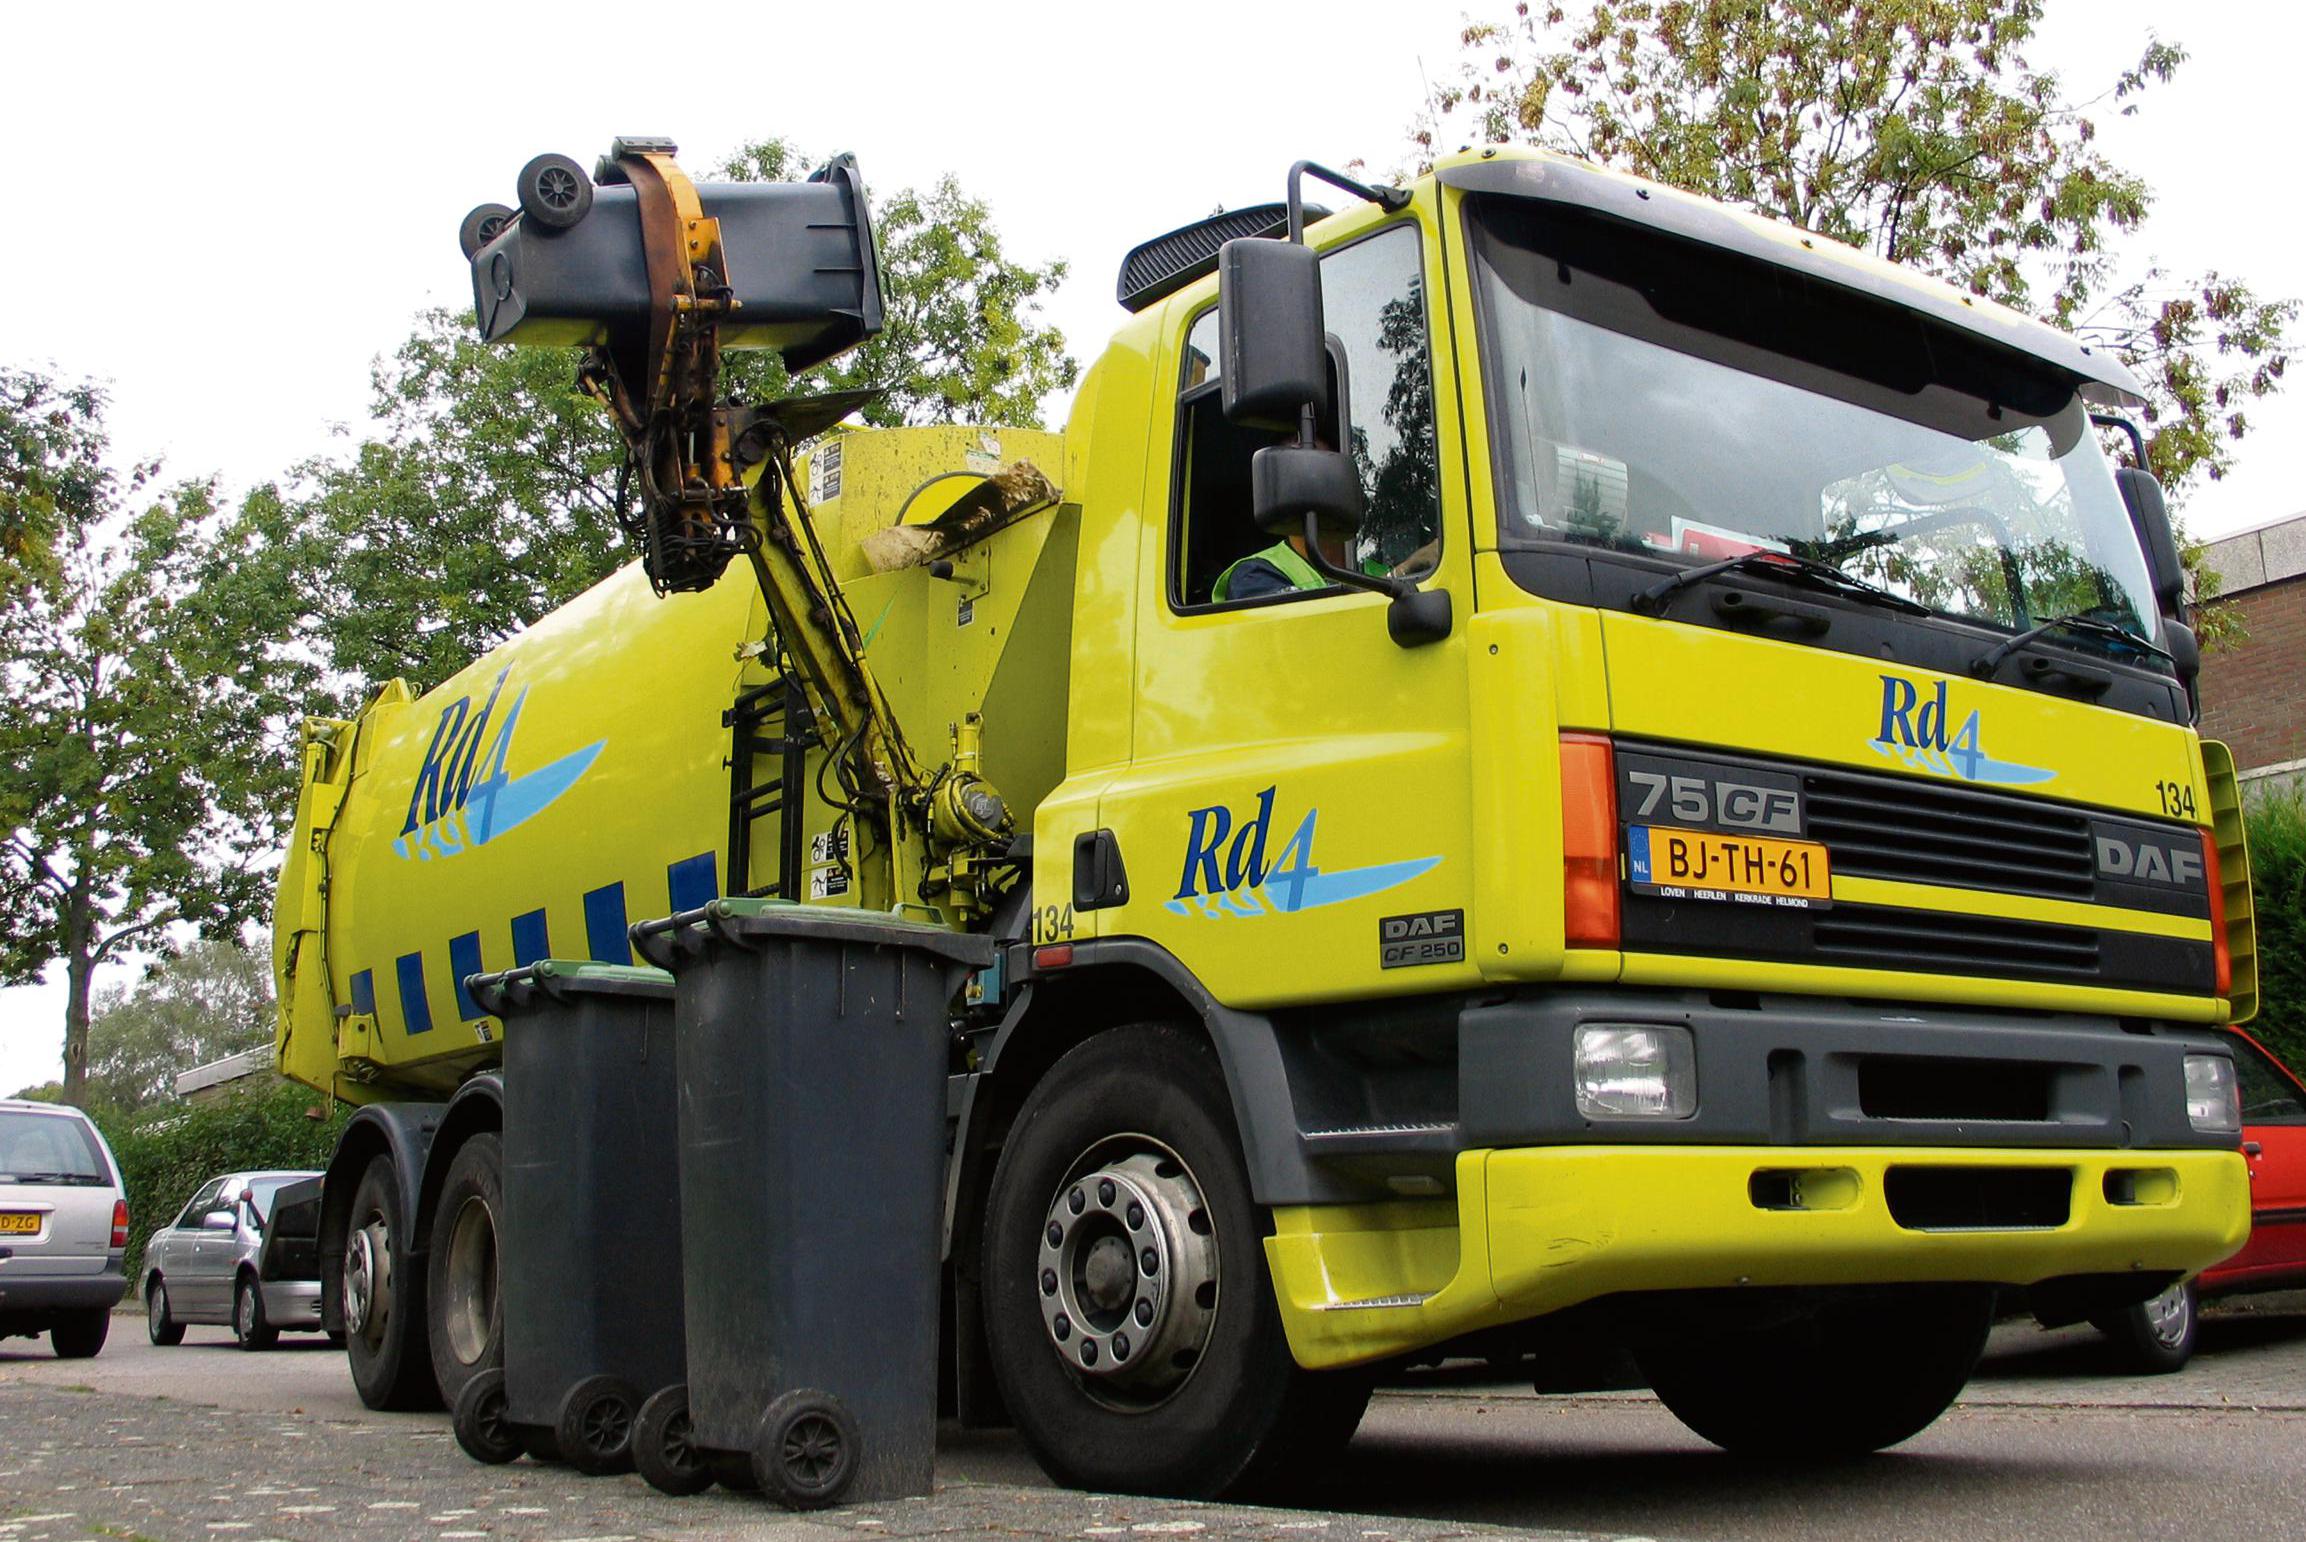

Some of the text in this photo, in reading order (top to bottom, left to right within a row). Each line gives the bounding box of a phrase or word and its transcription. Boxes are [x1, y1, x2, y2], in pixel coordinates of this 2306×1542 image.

[1875, 675, 1985, 780] Rd4
[399, 658, 531, 845] Rd4
[2155, 780, 2195, 819] 134
[1173, 785, 1320, 912] Rd4
[1633, 838, 1810, 889] NL BJ-TH-61
[2096, 836, 2203, 884] DAF
[1660, 886, 1808, 908] LOVEN HEERLEN KERKRADE HELMOND
[1033, 902, 1074, 943] 134
[1385, 914, 1456, 939] DAF
[1384, 942, 1460, 962] CF 250
[0, 1215, 34, 1229] D-ZG
